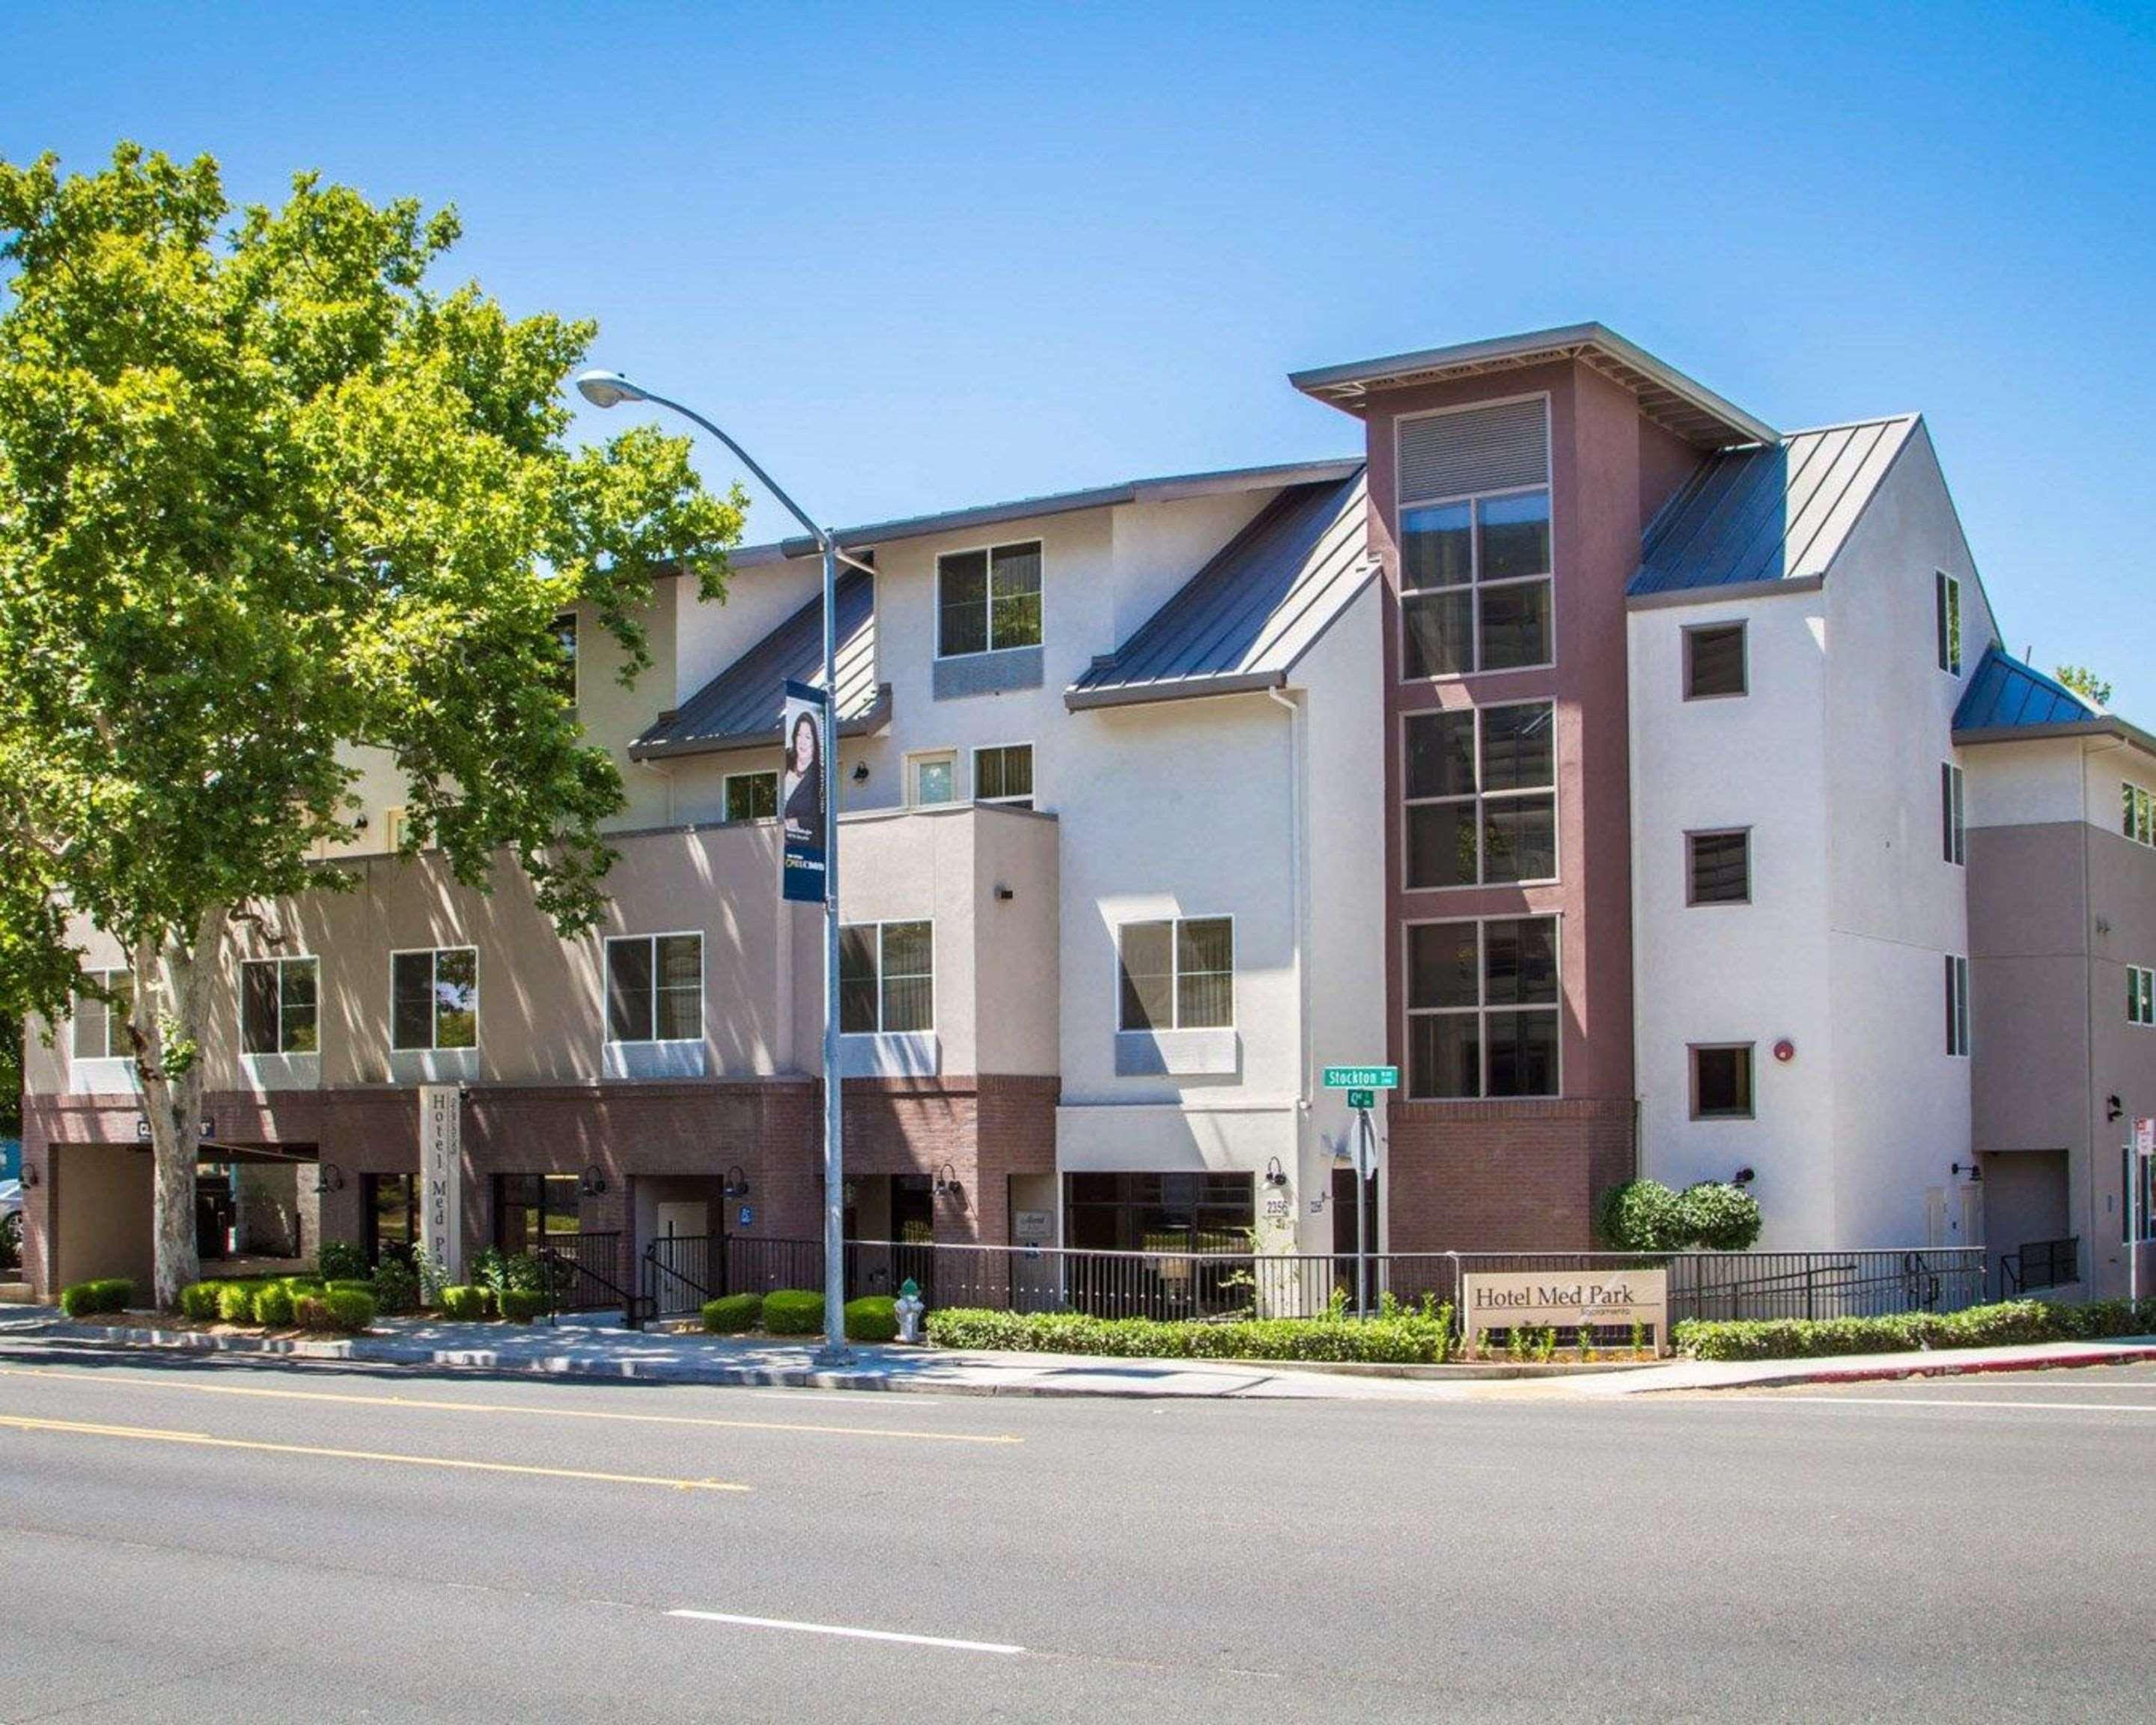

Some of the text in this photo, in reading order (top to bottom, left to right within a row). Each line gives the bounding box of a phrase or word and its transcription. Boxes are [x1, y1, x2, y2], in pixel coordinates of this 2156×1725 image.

[1329, 1071, 1377, 1085] Stockton
[433, 1094, 446, 1169] Hotel
[432, 1180, 447, 1226] Med
[1476, 1284, 1635, 1307] Hotel Med Park
